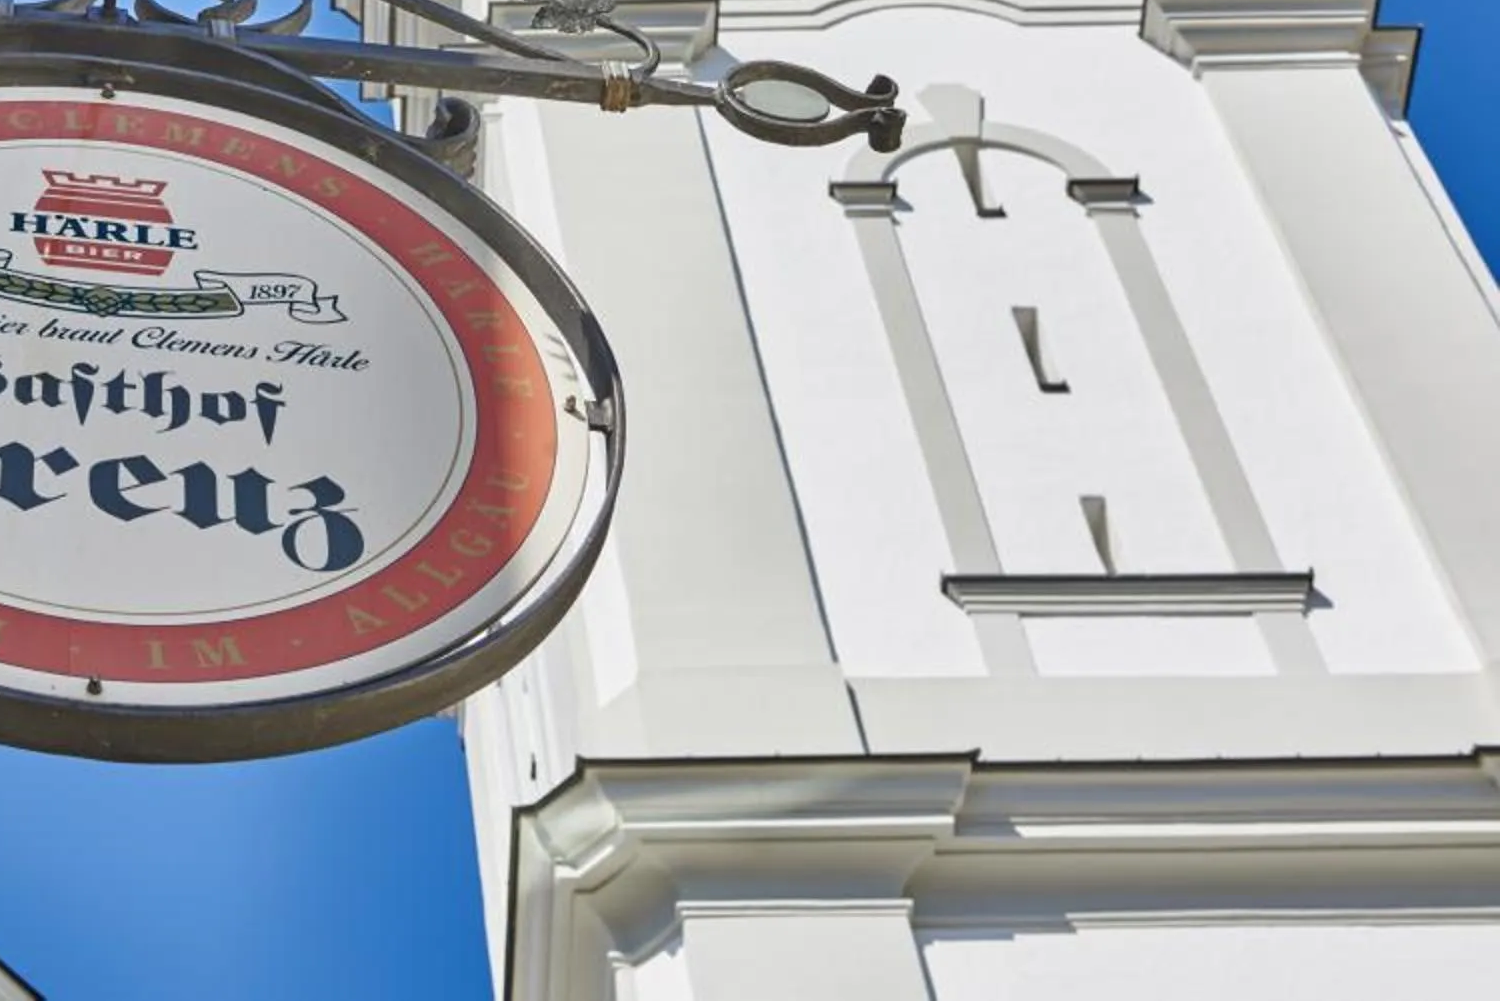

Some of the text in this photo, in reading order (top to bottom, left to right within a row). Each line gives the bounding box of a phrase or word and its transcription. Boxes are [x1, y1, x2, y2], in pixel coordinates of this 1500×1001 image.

[8, 106, 350, 199] CLEMENS
[8, 211, 200, 250] HÄRLE
[65, 242, 144, 262] BIER
[248, 283, 303, 300] 1897
[37, 317, 125, 345] braut
[131, 326, 259, 360] Clemens
[266, 340, 371, 372] Härle
[146, 634, 250, 672] IM
[345, 466, 531, 638] ALLGÄU
